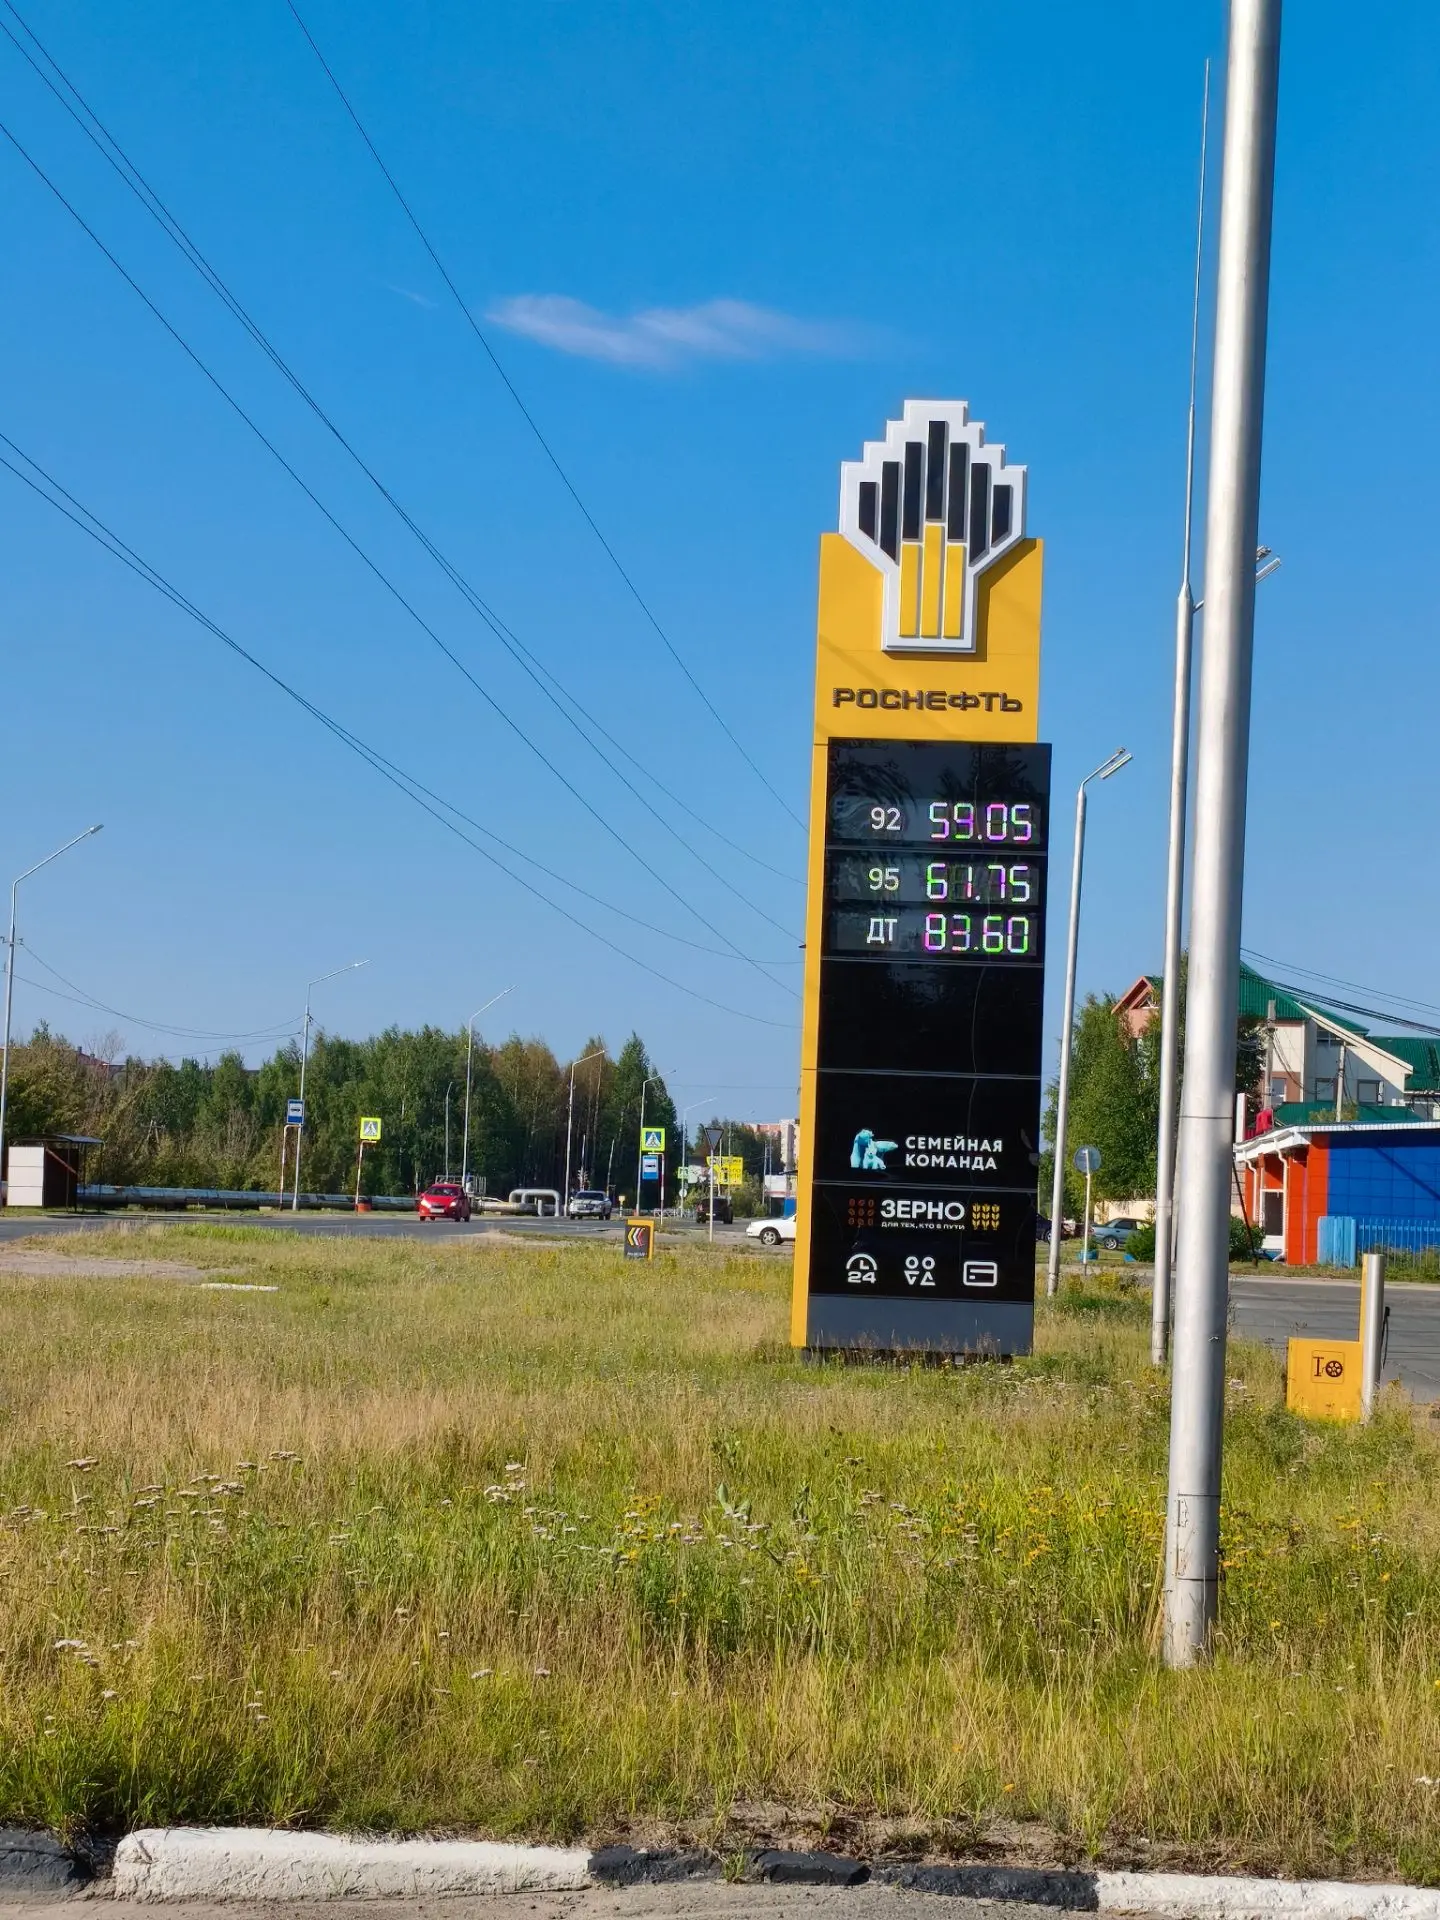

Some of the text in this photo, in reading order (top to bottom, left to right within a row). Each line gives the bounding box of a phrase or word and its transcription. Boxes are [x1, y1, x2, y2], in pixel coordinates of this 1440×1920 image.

[832, 687, 1023, 712] РОСНЕФТЬ
[870, 802, 1032, 842] 92 59.05
[868, 863, 1031, 903] 95 61.75
[866, 913, 1029, 954] ДТ 83.60
[905, 1135, 1003, 1153] СЕМЕЙНАЯ
[905, 1153, 997, 1170] КОМАНДА
[880, 1199, 965, 1221] ЗЕРНО
[847, 1271, 877, 1284] 24
